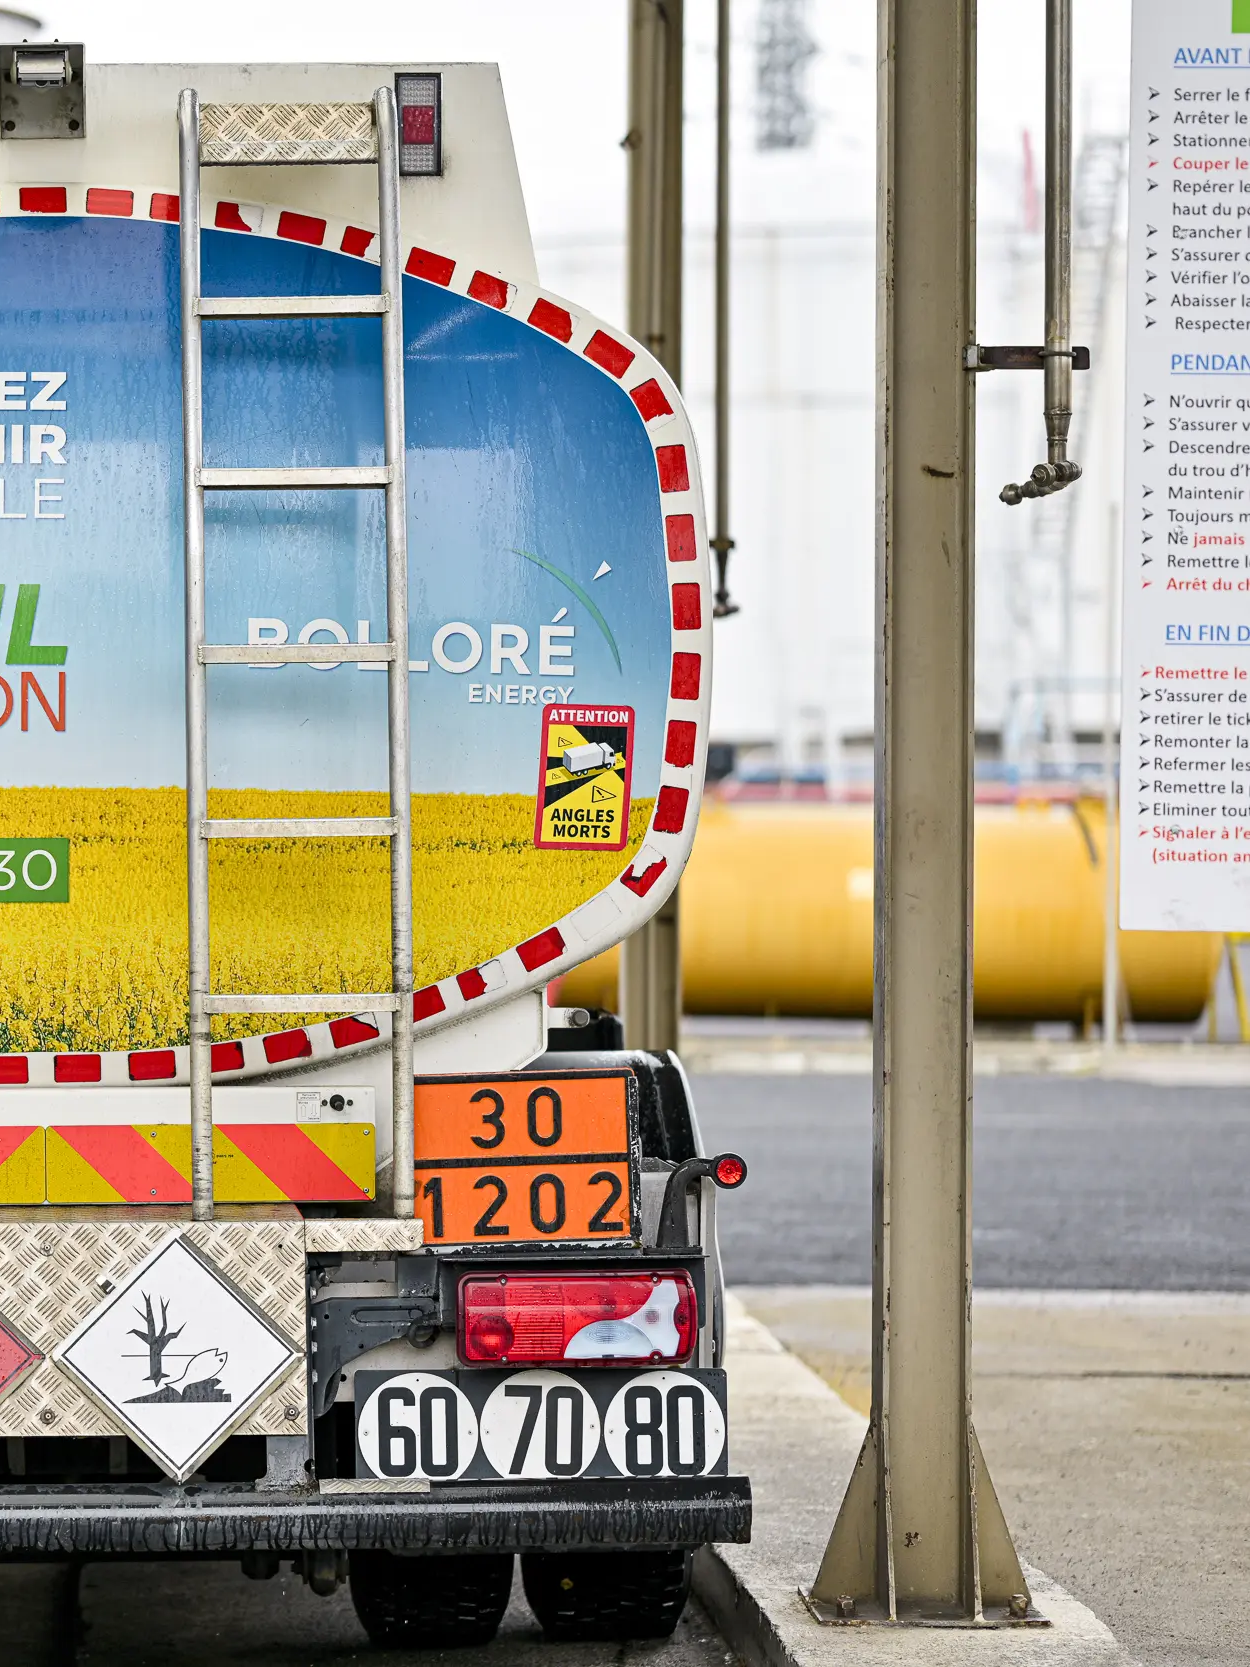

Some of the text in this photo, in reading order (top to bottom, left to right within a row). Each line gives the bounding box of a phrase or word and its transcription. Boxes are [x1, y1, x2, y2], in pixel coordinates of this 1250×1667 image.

[1174, 48, 1242, 64] AVANT
[1174, 88, 1222, 101] Serrer
[1227, 88, 1240, 101] le
[1173, 111, 1248, 124] Arrêter le
[1173, 157, 1249, 173] Couper le
[1172, 179, 1234, 196] Repérer
[1172, 202, 1207, 216] haut
[1212, 202, 1231, 216] du
[1171, 248, 1240, 261] S'assurer
[1171, 271, 1228, 284] Vérifier
[1170, 294, 1236, 307] Abaisser
[1175, 316, 1250, 333] Respecter
[1169, 394, 1231, 408] N'ouvrir
[1168, 417, 1238, 431] S'assurer
[1169, 440, 1250, 454] Descendre
[1168, 463, 1187, 477] du
[1193, 465, 1225, 477] trou
[0, 478, 66, 520] LE
[1168, 486, 1244, 500] Maintenir
[1167, 508, 1234, 526] Toujours
[1167, 532, 1245, 548] Ne jamais
[1167, 554, 1240, 568] Remettre
[1166, 577, 1207, 591] Arrêt
[1212, 577, 1232, 591] du
[1166, 624, 1191, 641] EN
[1199, 625, 1230, 641] FIN
[1155, 666, 1247, 680] Remettre le
[468, 683, 575, 705] ENERGY
[1154, 688, 1247, 703] S'assurer de
[549, 709, 629, 723] ATTENTION
[1154, 711, 1204, 725] retirer
[1208, 712, 1221, 726] le
[1154, 734, 1248, 748] Remonter la
[1154, 757, 1250, 771] Refermer les
[1153, 780, 1226, 794] Remettre
[1231, 781, 1243, 794] la
[550, 808, 615, 823] ANGLES
[1153, 803, 1217, 817] Eliminer
[552, 824, 611, 839] MORTS
[1153, 825, 1217, 843] Signaler
[1221, 826, 1229, 840] à
[1152, 848, 1228, 865] (situation
[469, 1086, 563, 1149] 30
[423, 1171, 624, 1238] 1202
[378, 1386, 458, 1477] 60
[504, 1385, 584, 1476] 70
[624, 1385, 706, 1477] 80
